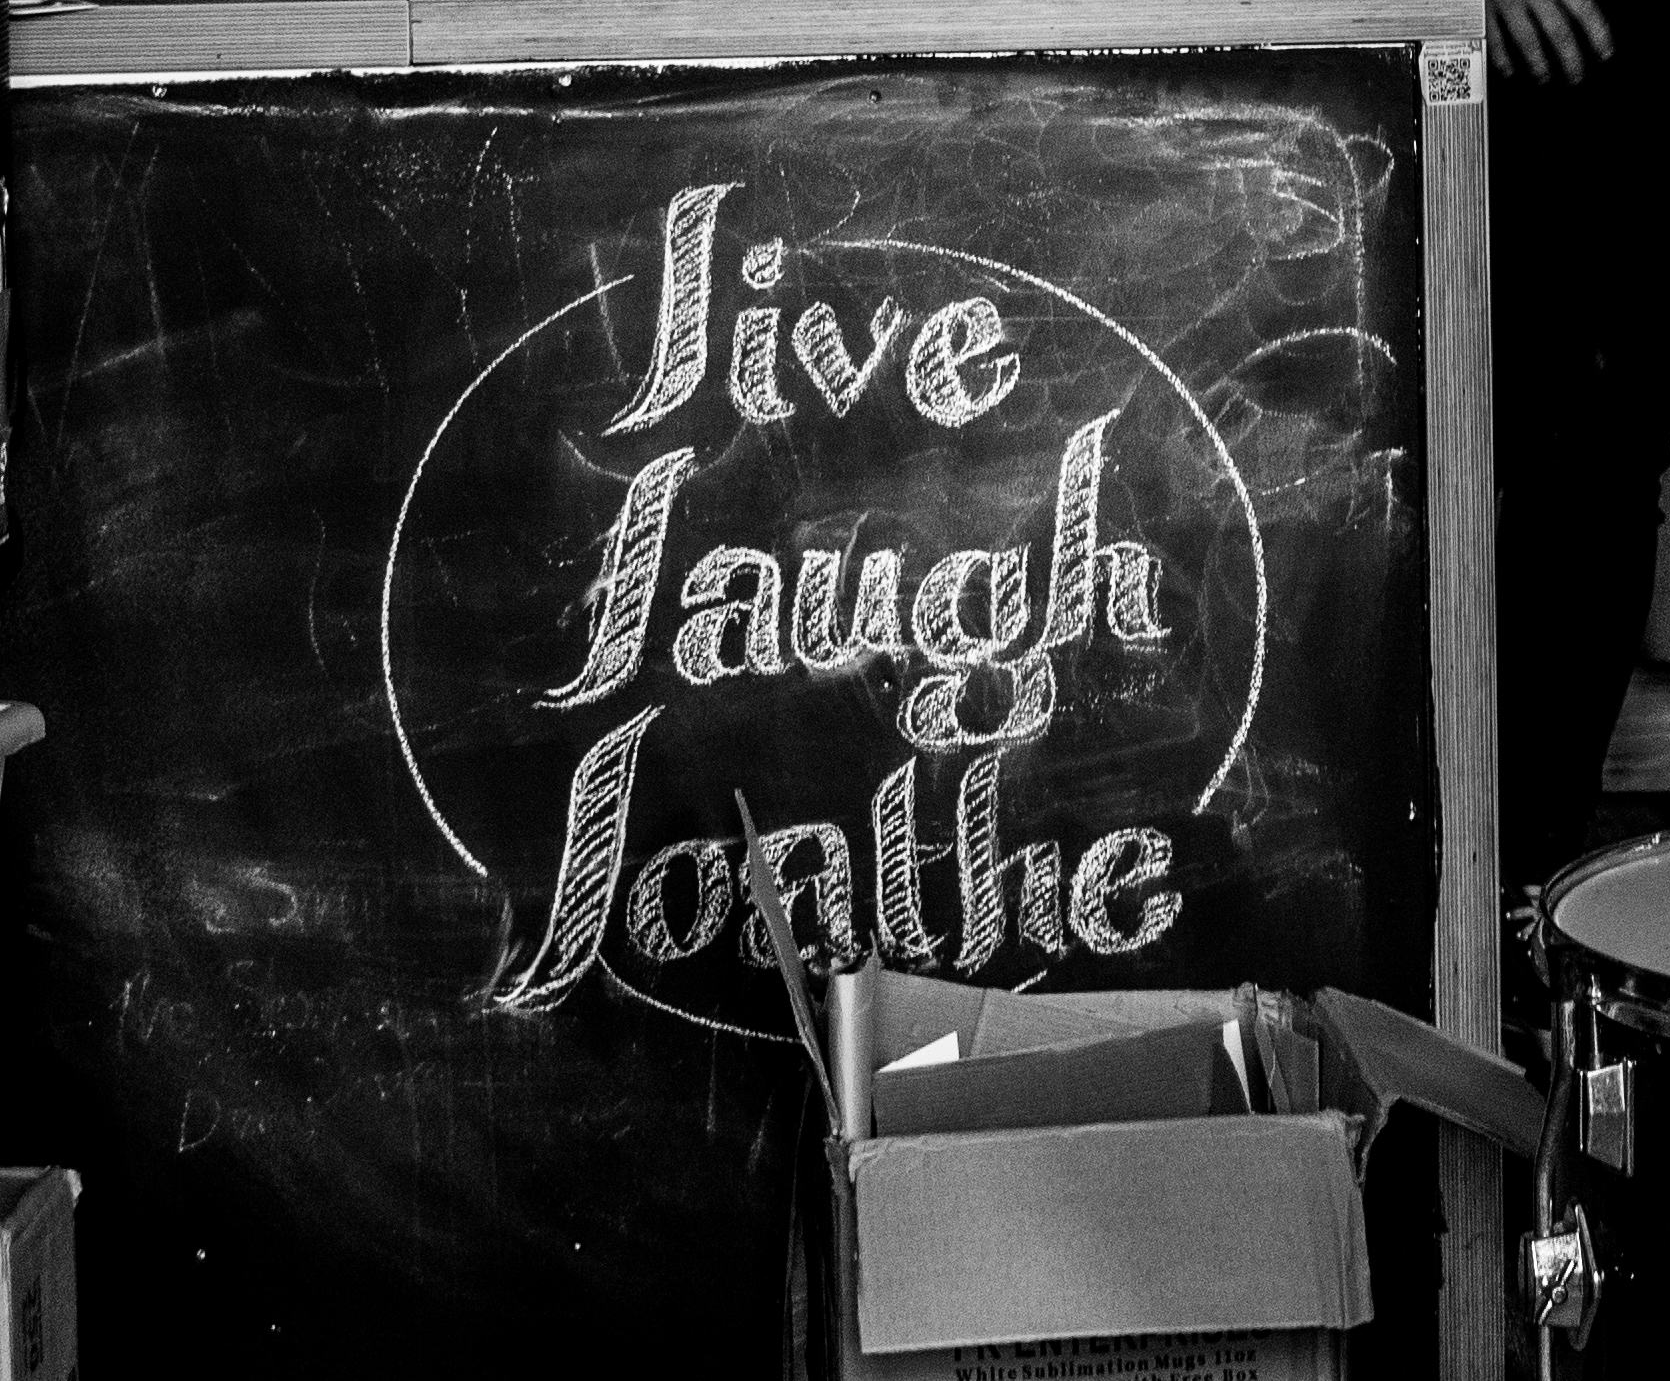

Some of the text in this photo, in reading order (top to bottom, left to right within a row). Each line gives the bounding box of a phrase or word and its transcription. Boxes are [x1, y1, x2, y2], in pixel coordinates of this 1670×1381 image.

[956, 1367, 1018, 1381] White
[1022, 1358, 1149, 1380] Sublimation
[1154, 1354, 1206, 1371] Mugs
[1215, 1350, 1257, 1365] 11oz
